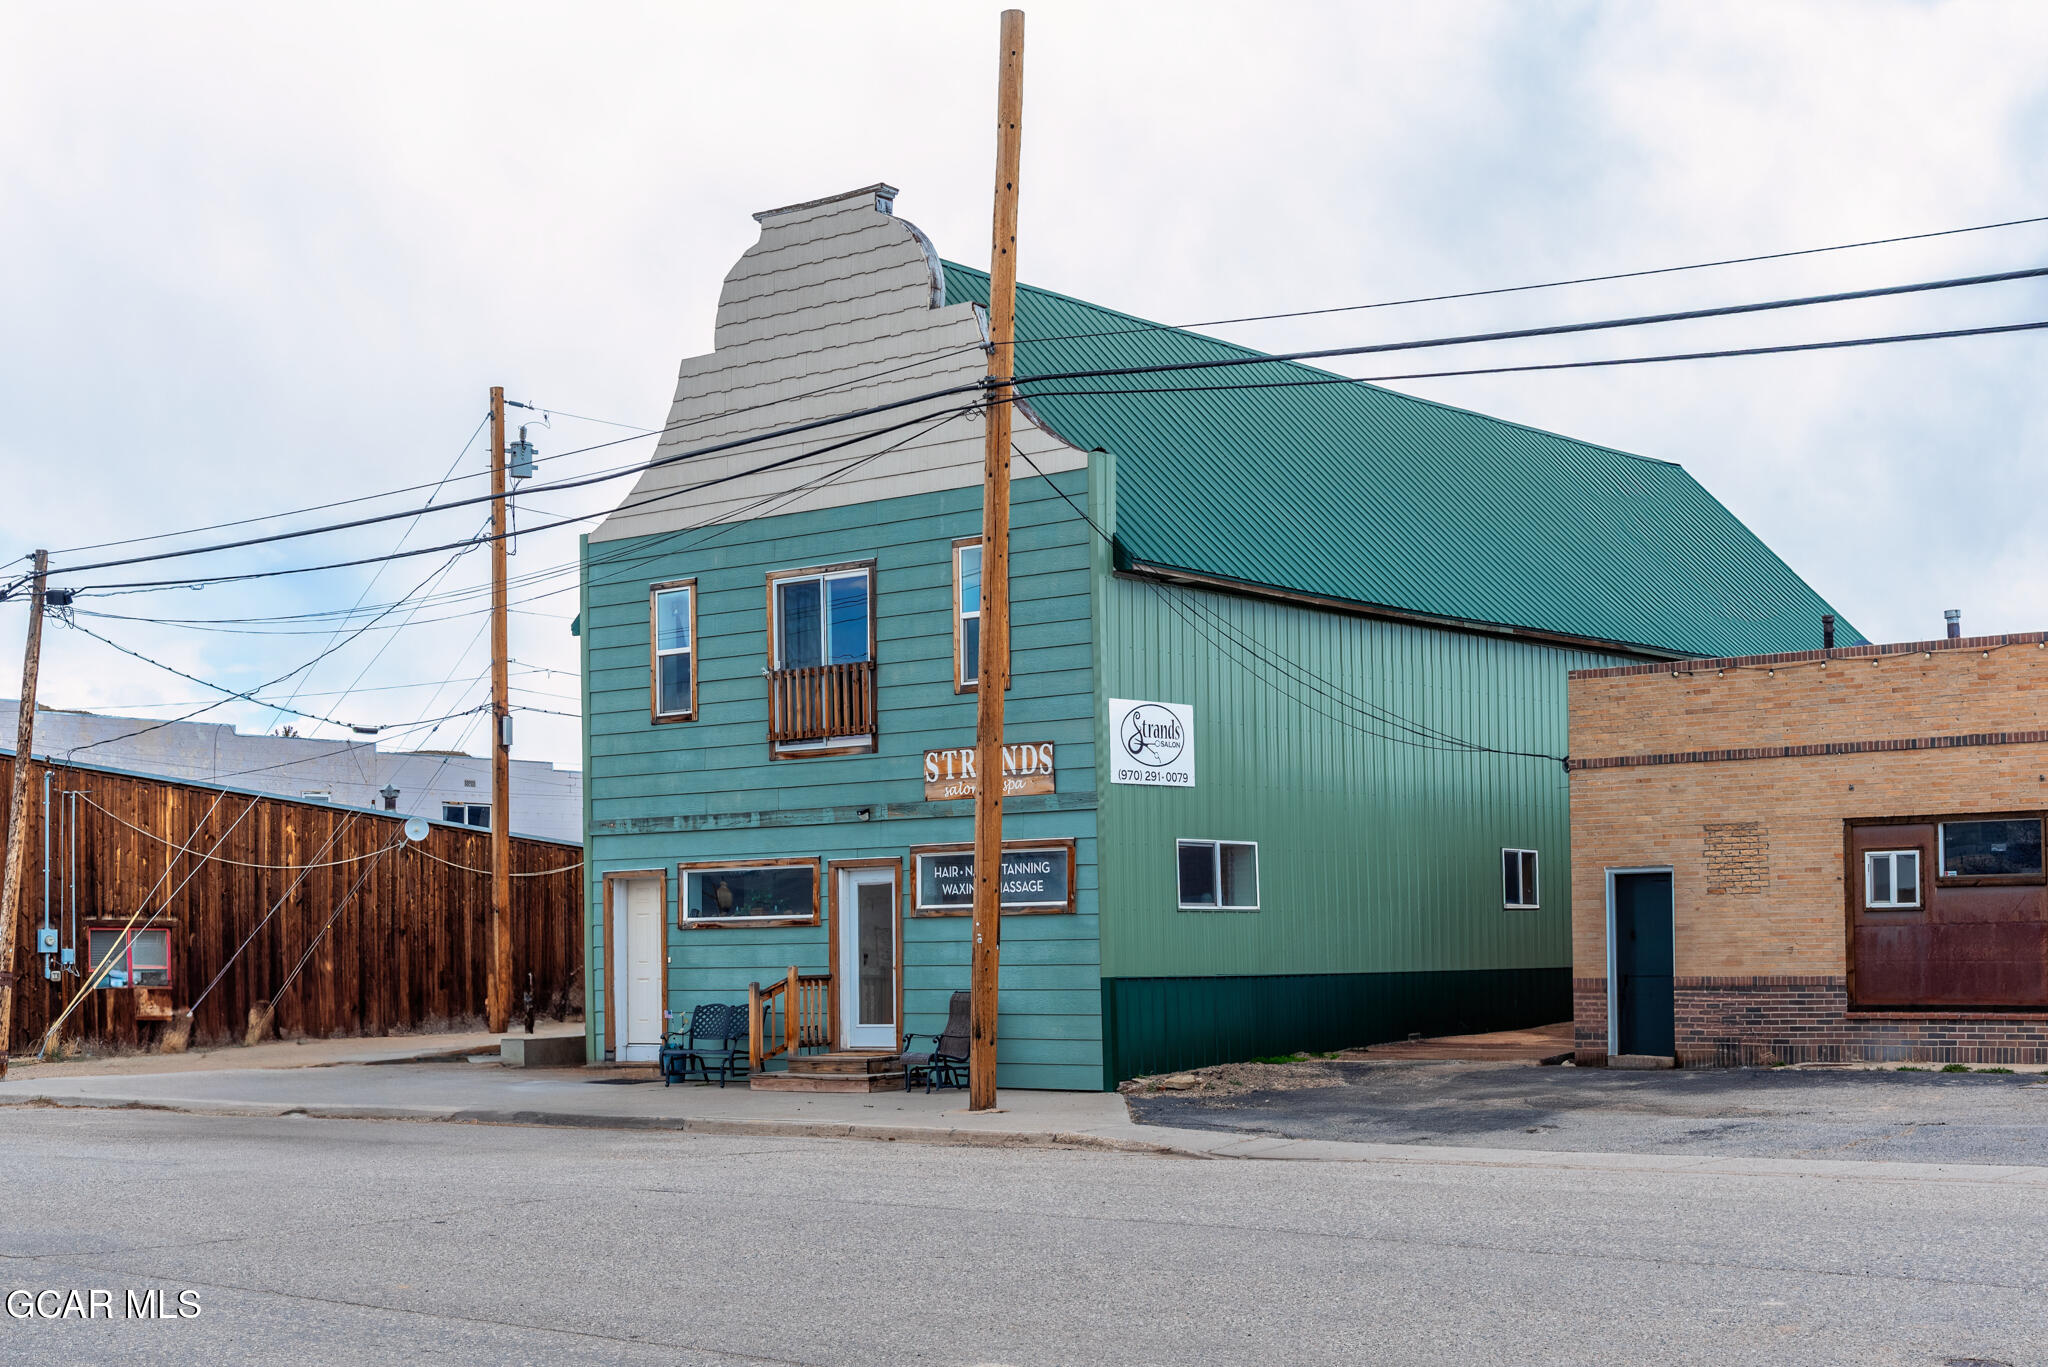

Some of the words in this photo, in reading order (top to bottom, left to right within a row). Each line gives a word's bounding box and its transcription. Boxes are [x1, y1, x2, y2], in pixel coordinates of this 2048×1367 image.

[1128, 711, 1180, 754] Strands
[1161, 740, 1180, 748] SALON
[925, 743, 1053, 783] STRNDS
[1118, 768, 1142, 781] (970)
[1145, 771, 1188, 783] 291-0079
[1002, 778, 1026, 794] spa
[934, 866, 958, 878] HAIR
[1002, 861, 1050, 875] TANNING
[942, 883, 974, 895] WAXIN
[1001, 880, 1044, 893] ASSAGE
